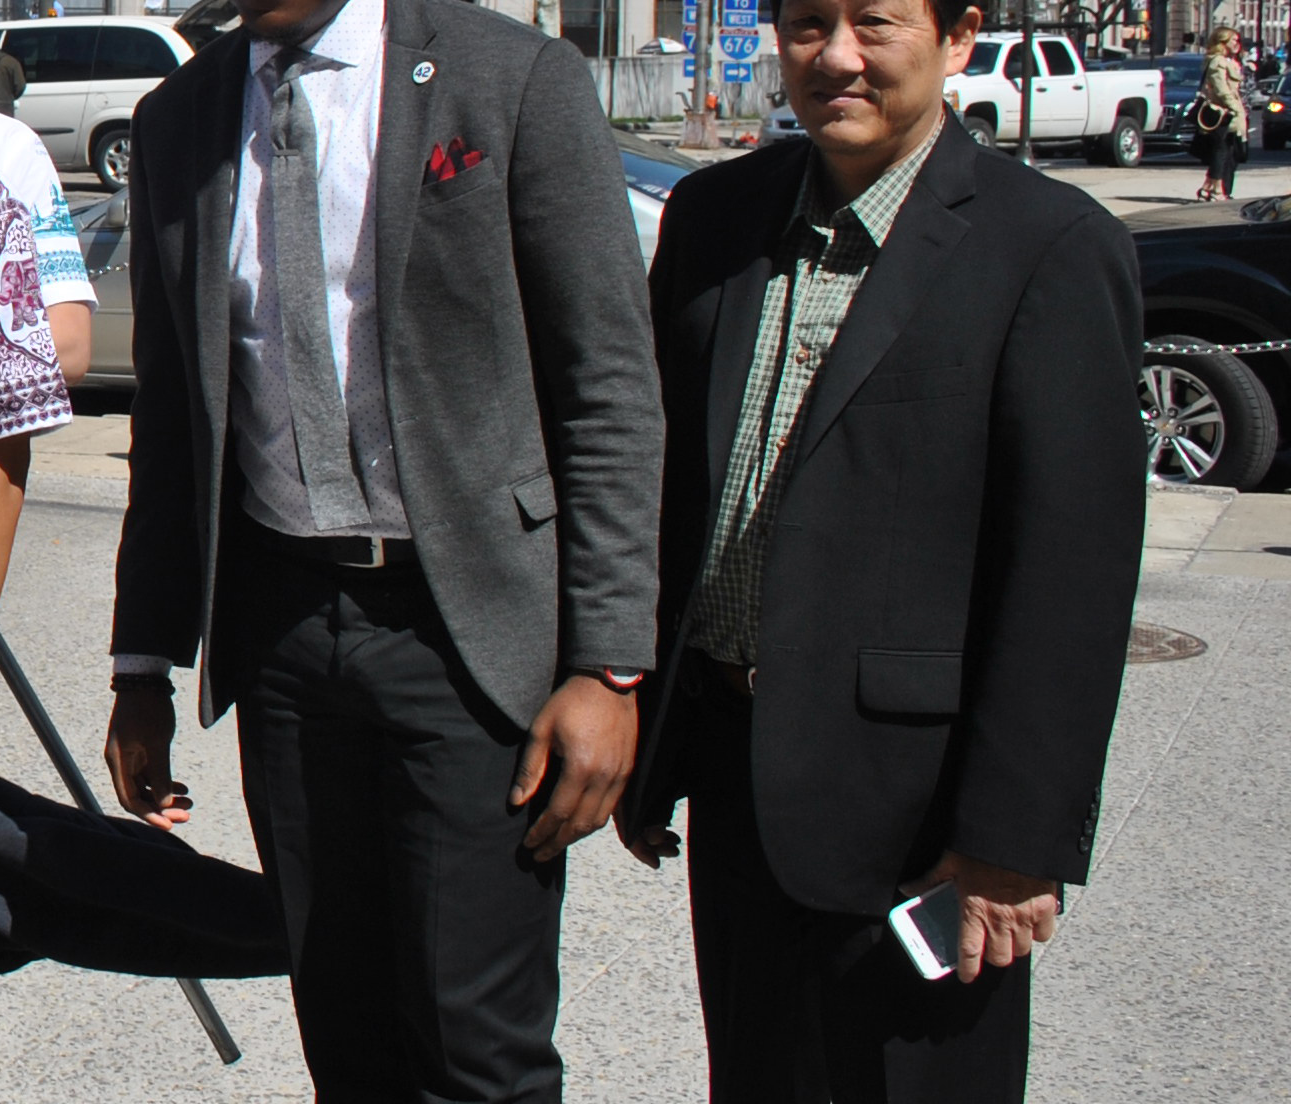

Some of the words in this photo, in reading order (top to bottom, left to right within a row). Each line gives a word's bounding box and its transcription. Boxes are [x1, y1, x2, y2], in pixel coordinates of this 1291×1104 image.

[729, 14, 753, 25] WEST
[723, 37, 754, 54] 676
[415, 66, 431, 78] 42
